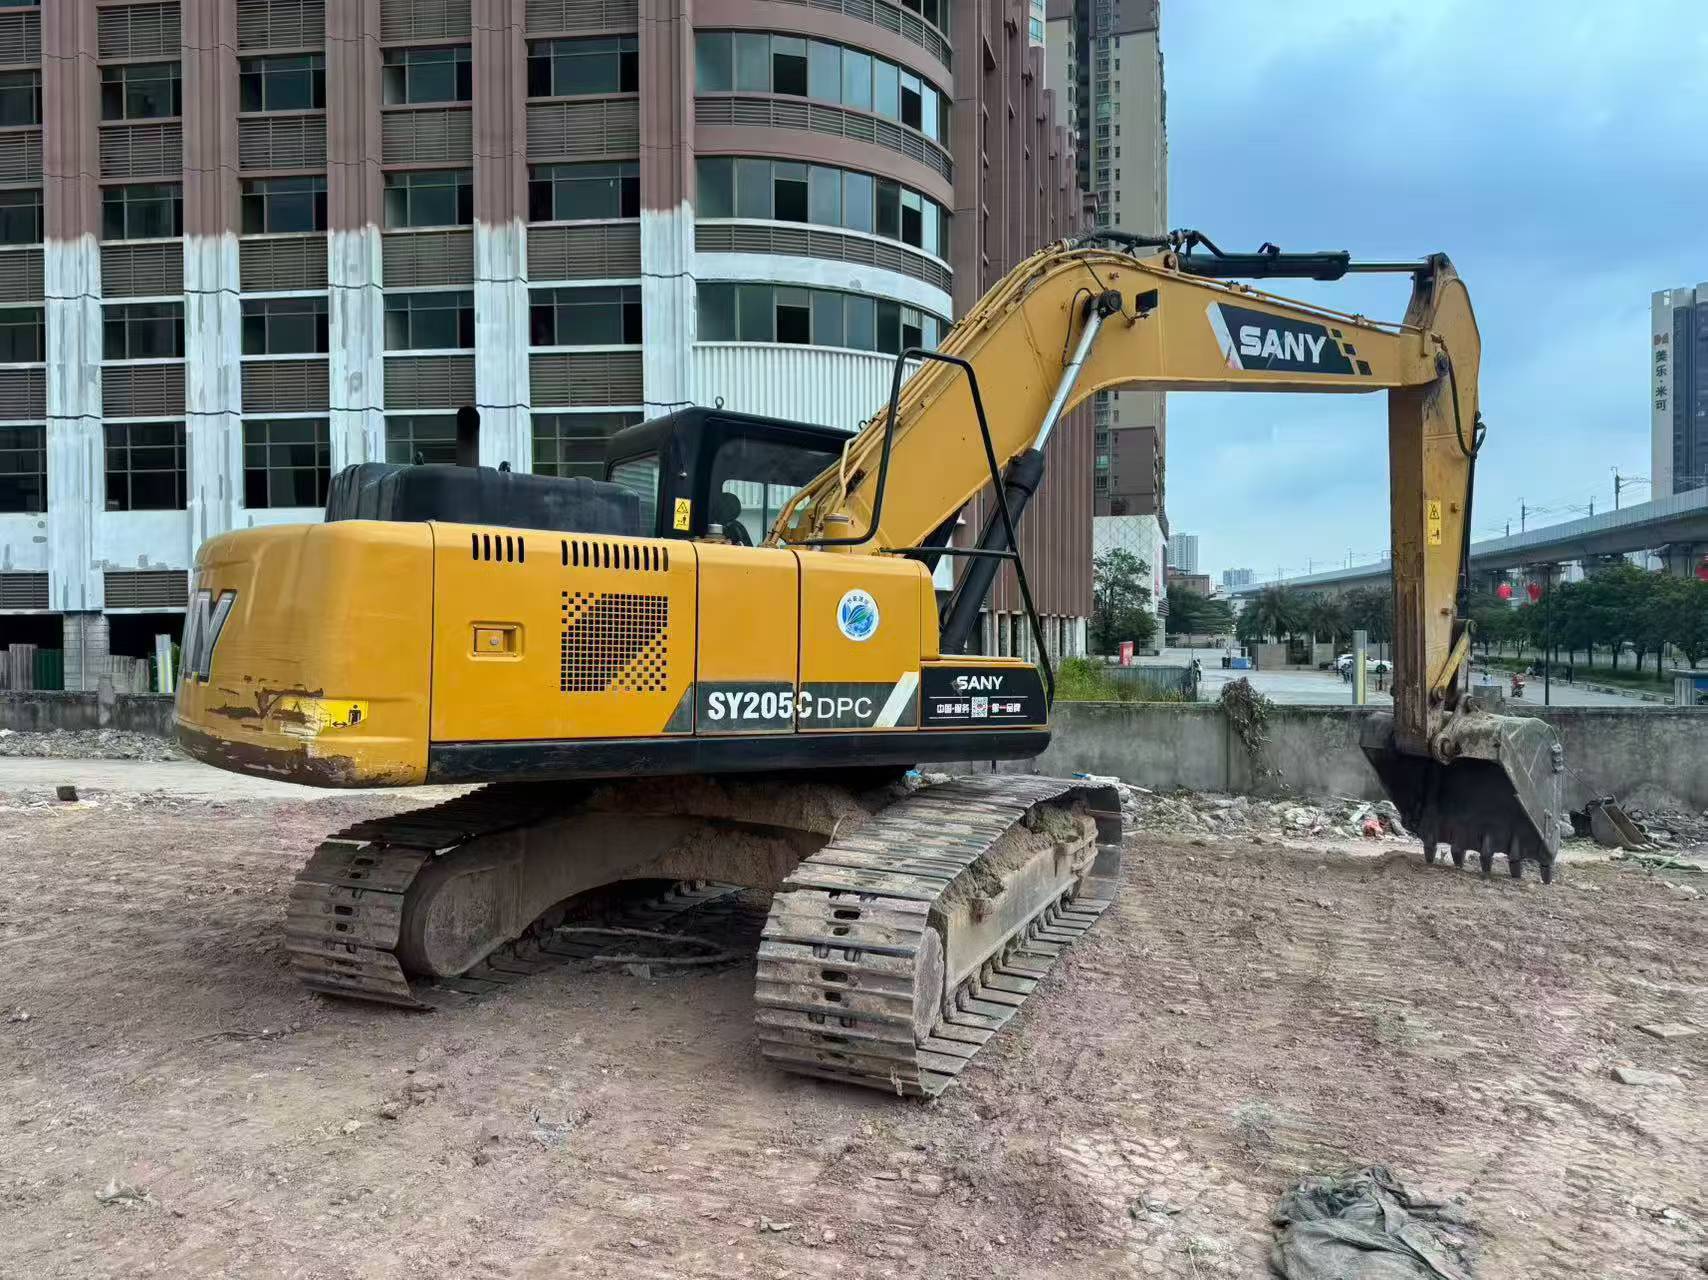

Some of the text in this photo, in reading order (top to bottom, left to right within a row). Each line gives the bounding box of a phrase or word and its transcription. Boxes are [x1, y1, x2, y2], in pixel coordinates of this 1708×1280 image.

[1240, 325, 1327, 364] SANY
[957, 675, 1003, 690] SANY
[708, 691, 873, 721] SY205C DPC
